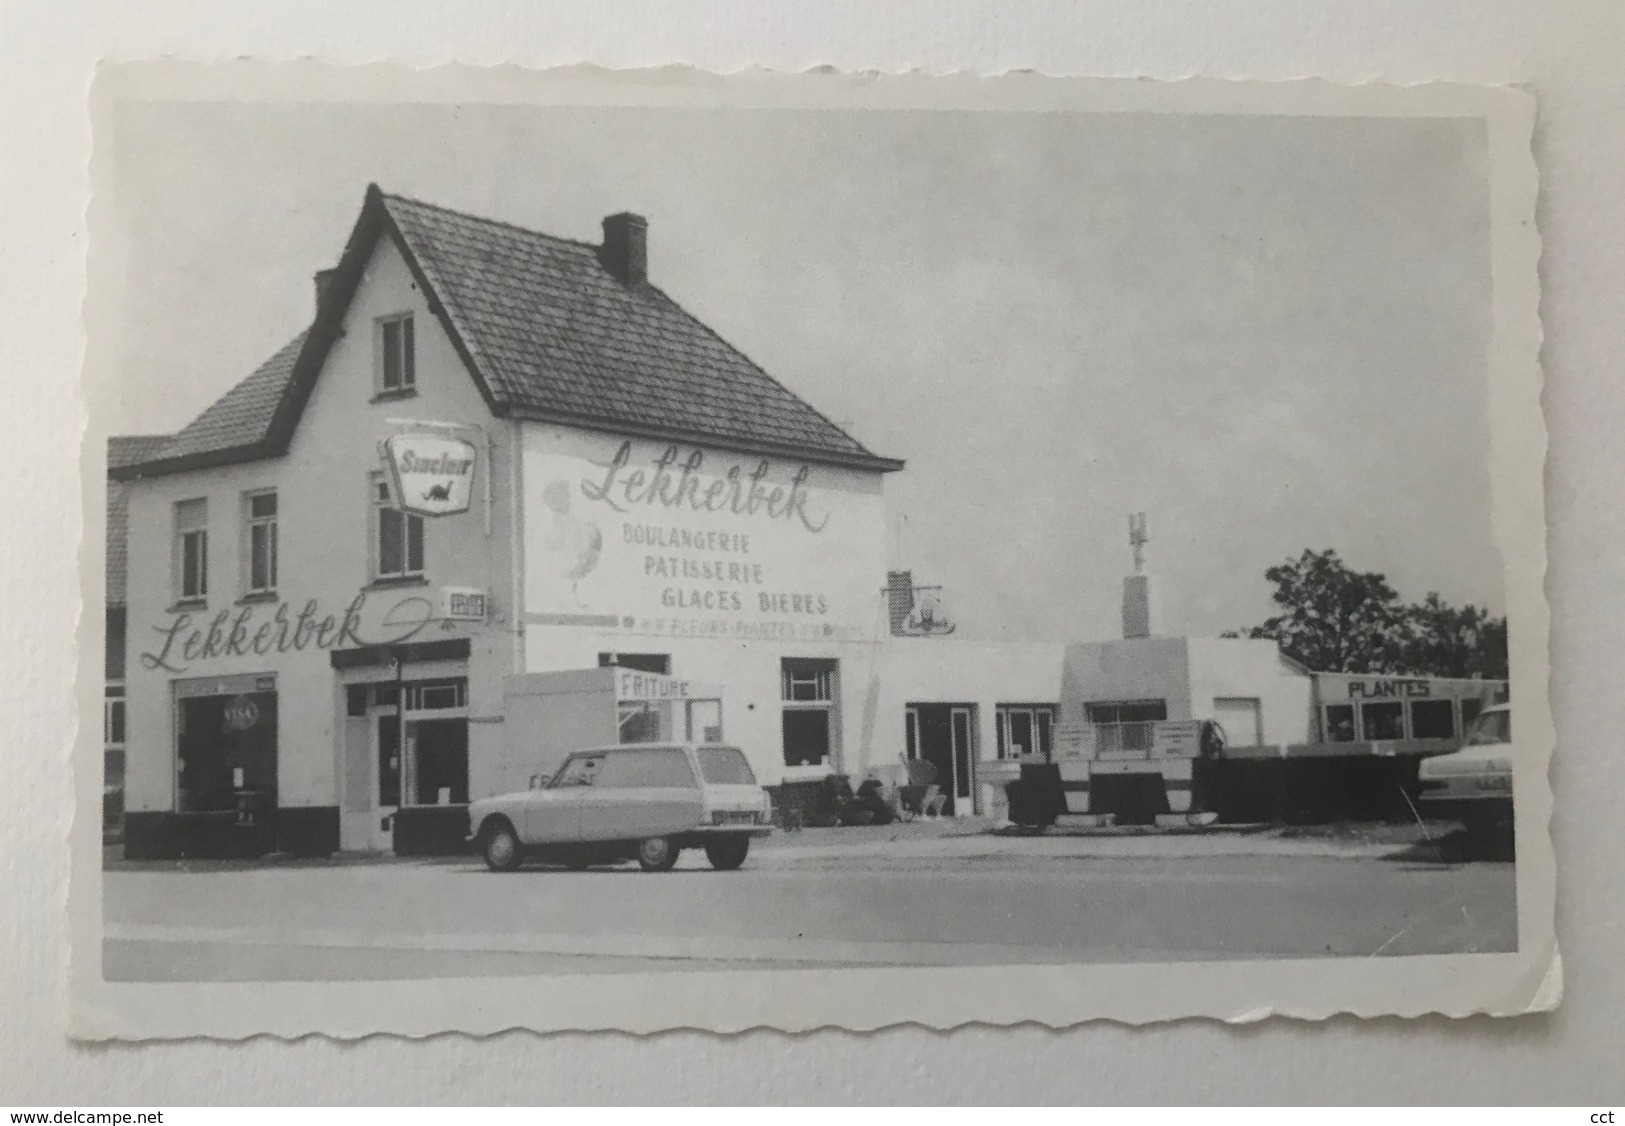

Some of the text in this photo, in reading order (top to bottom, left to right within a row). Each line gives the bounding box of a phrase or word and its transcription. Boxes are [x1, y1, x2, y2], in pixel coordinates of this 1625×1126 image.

[581, 440, 829, 532] Lekkerbek
[622, 522, 750, 554] BOULANGERIE
[644, 555, 763, 584] PATISSERIE
[661, 587, 828, 615] GLACES BIERES
[140, 592, 433, 673] Lekkerbek
[621, 674, 690, 696] FRITURE
[1348, 680, 1430, 698] PLANTES
